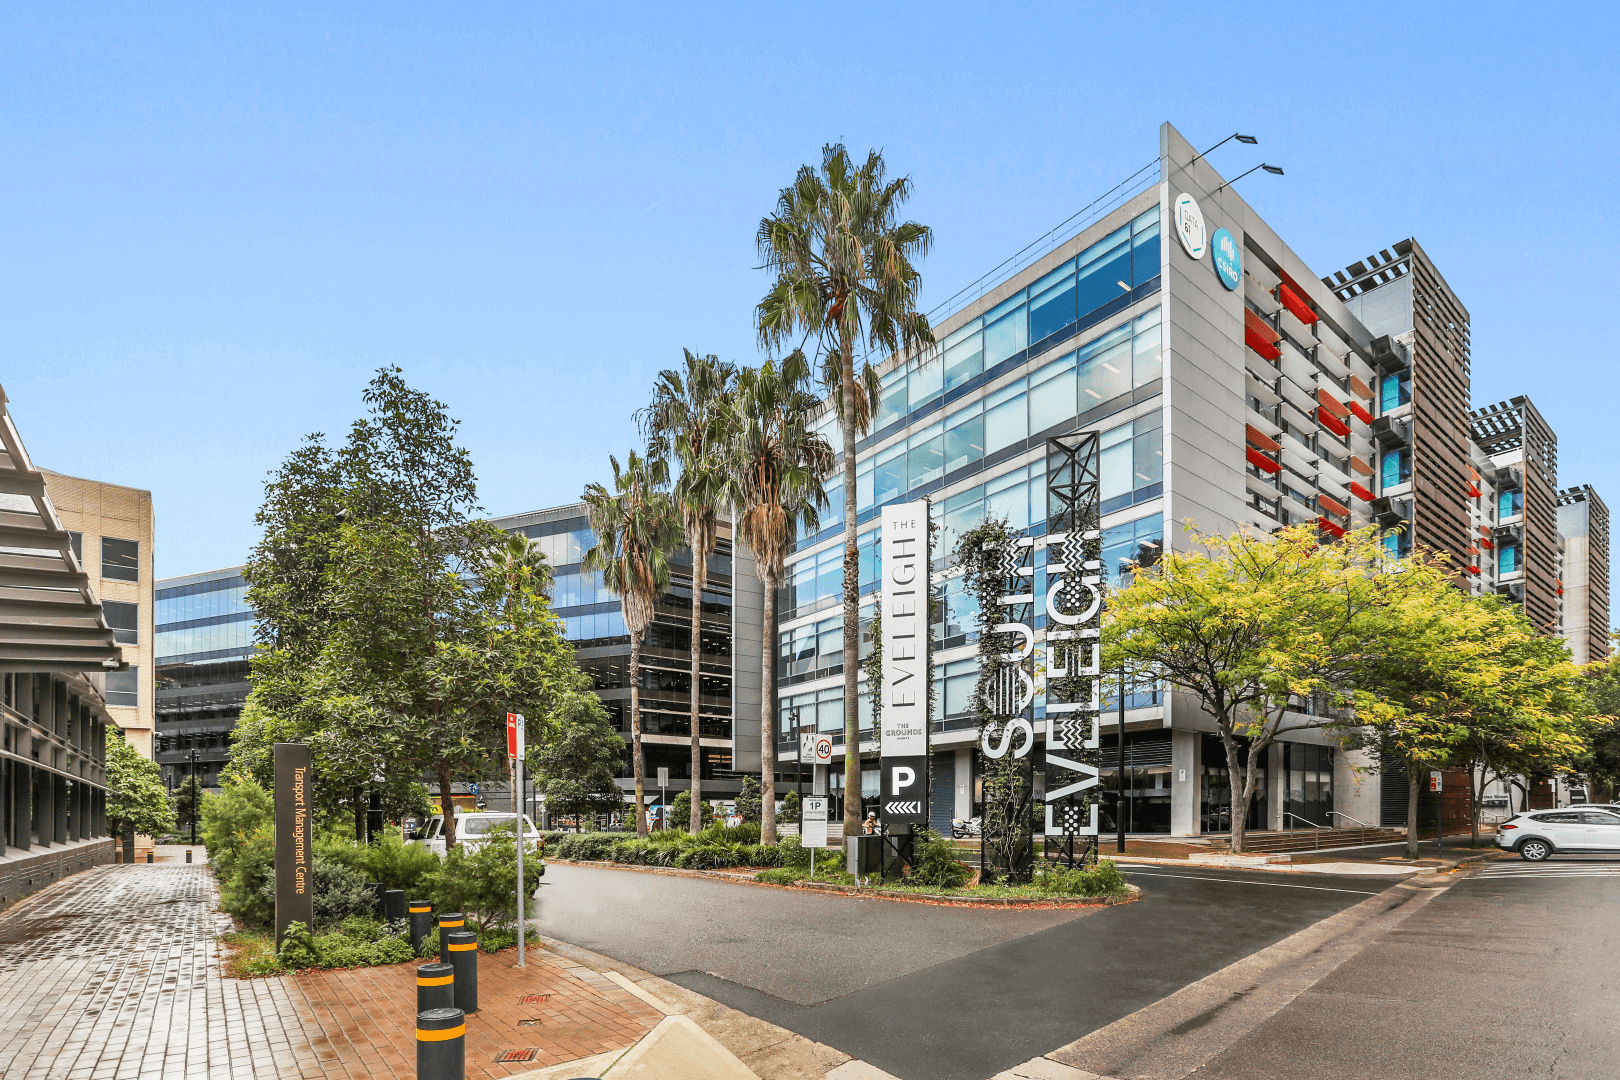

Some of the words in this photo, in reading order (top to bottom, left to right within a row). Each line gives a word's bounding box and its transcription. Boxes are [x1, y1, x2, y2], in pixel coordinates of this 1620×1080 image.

[1184, 210, 1198, 230] DATA
[1184, 223, 1191, 235] 61
[1217, 257, 1238, 282] CSIRO
[892, 519, 916, 530] THE
[892, 537, 916, 707] EVELEIGH
[885, 728, 922, 736] GROUNDS
[818, 744, 830, 754] 40
[292, 766, 307, 806] Transport
[892, 766, 916, 795] P
[809, 802, 821, 810] 1P
[292, 808, 307, 864] Management
[295, 866, 307, 894] Centre
